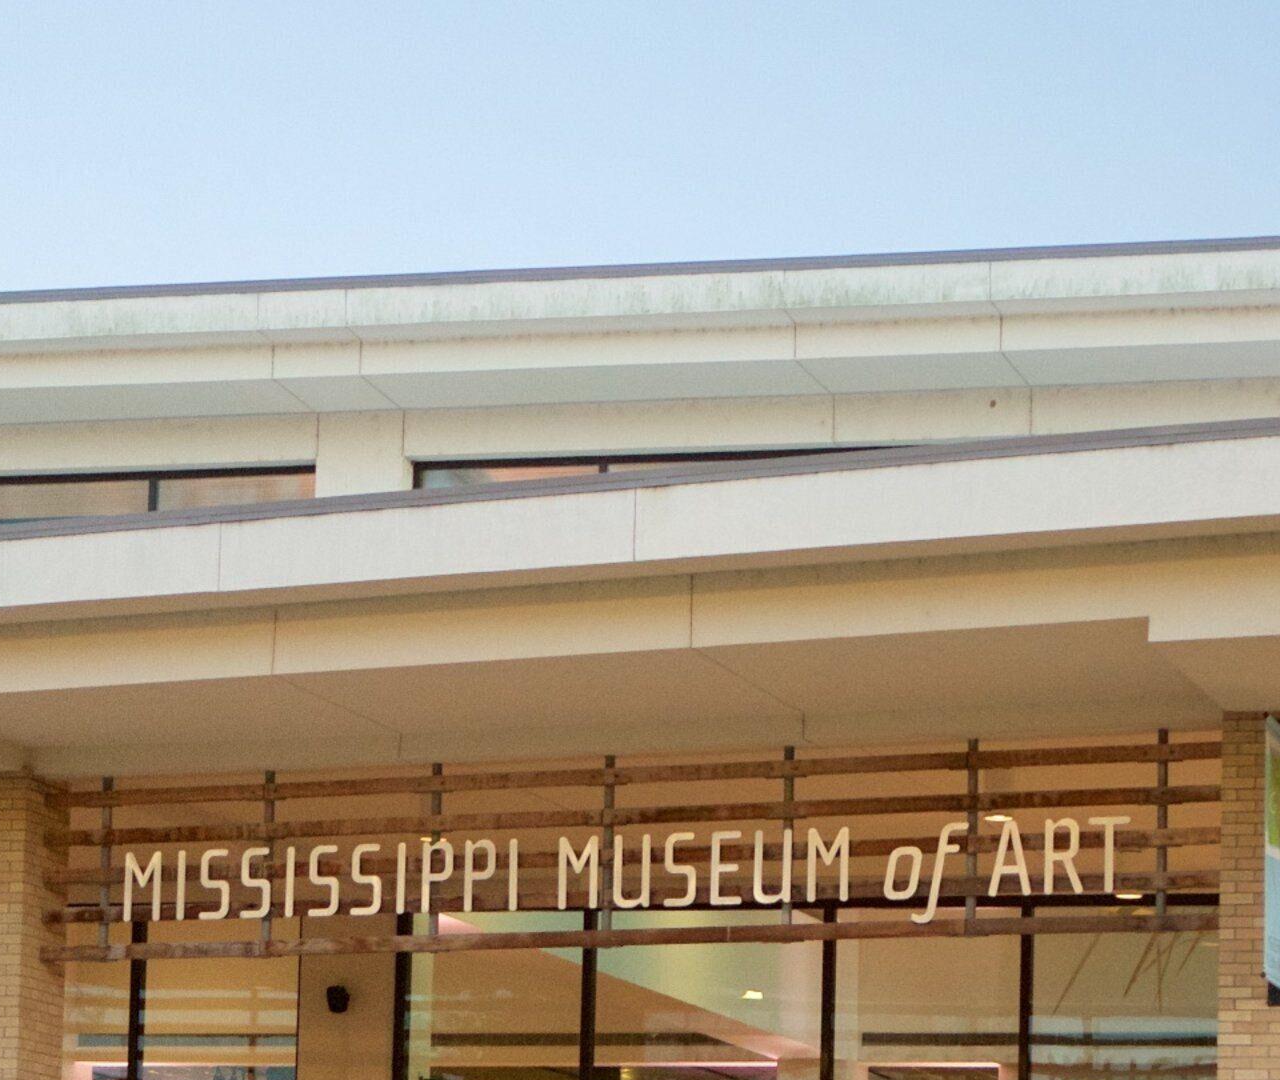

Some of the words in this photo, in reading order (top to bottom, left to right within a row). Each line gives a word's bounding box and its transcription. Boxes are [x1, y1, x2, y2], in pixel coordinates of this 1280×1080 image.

[122, 838, 519, 923] MISSISSIPPI
[557, 827, 850, 910] MUSEUM
[882, 822, 969, 924] of
[984, 816, 1132, 897] ART
